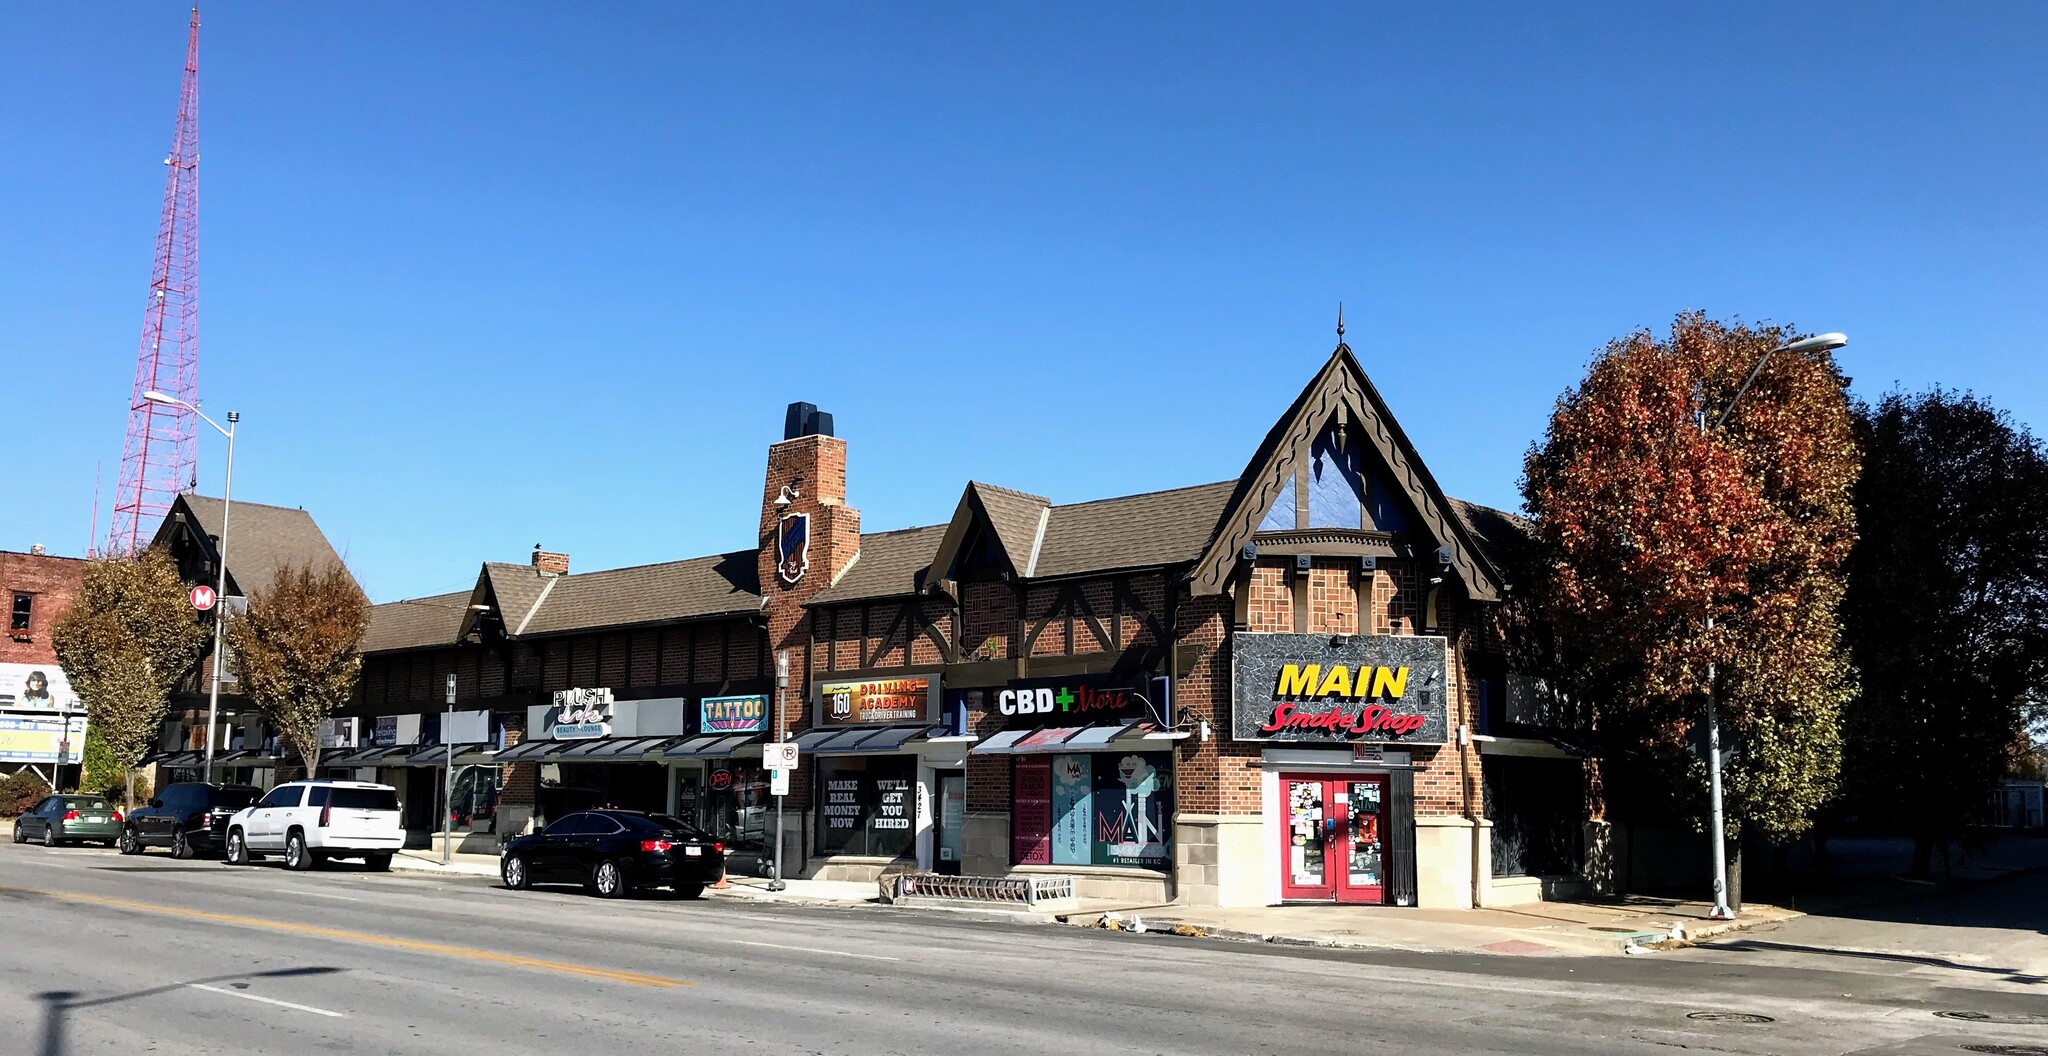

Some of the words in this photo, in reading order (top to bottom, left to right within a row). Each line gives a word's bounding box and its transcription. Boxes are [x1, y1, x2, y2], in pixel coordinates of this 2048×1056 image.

[1277, 664, 1409, 698] MAIN
[860, 681, 917, 696] DRIVING
[554, 687, 606, 708] PLUSH
[832, 693, 850, 714] 160
[859, 696, 917, 710] ACADEMY
[558, 695, 602, 729] Life
[705, 700, 764, 719] TATTOO
[1261, 702, 1355, 732] Smoke
[1350, 704, 1425, 735] Shop
[556, 726, 576, 734] BEAUTY
[581, 724, 601, 733] LOUNGE
[1354, 743, 1365, 757] NO
[709, 772, 731, 787] OPEN
[828, 780, 858, 791] MAKE
[877, 780, 909, 790] WE'LL
[829, 793, 856, 803] REAL
[882, 792, 903, 803] GET
[824, 805, 861, 816] MONEY
[881, 805, 903, 816] YOU
[830, 818, 854, 828] NOW
[875, 818, 910, 829] HIRED
[1020, 852, 1044, 861] DETOX
